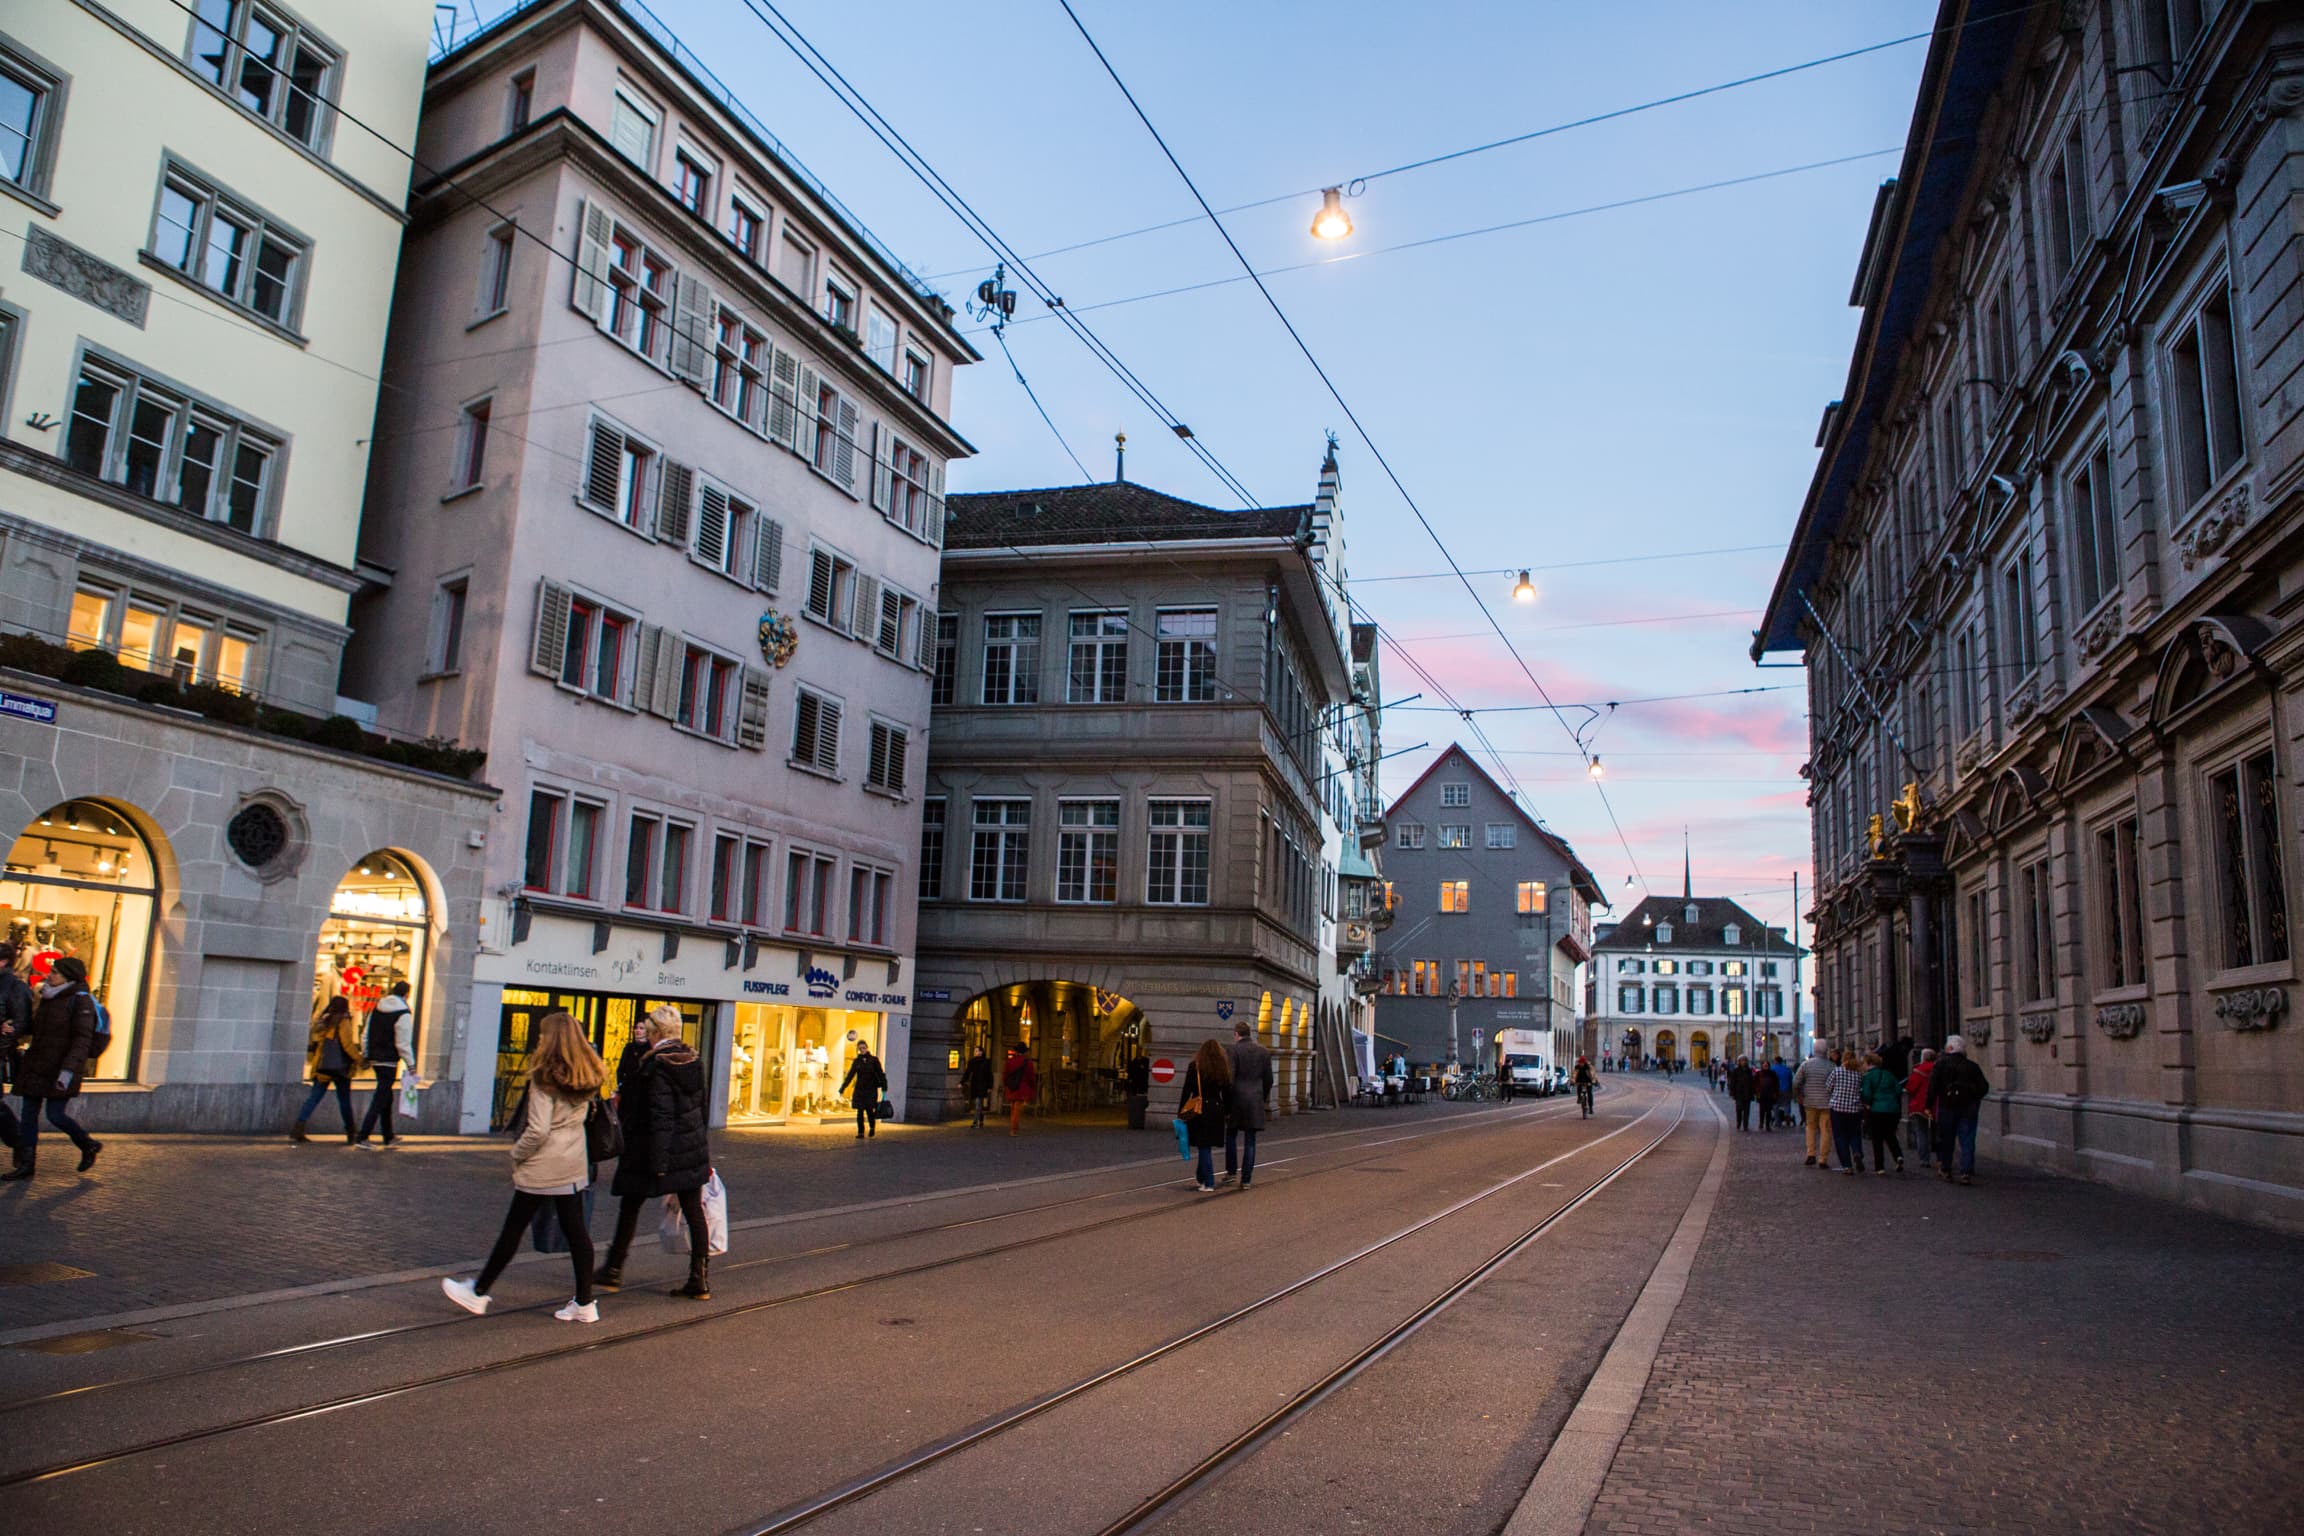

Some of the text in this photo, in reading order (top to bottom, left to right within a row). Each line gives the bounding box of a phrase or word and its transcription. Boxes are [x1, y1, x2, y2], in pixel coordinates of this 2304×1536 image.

[526, 959, 597, 978] Kontaktlinsen
[657, 971, 686, 987] Brillen
[743, 980, 789, 996] FUSSPFLEGE
